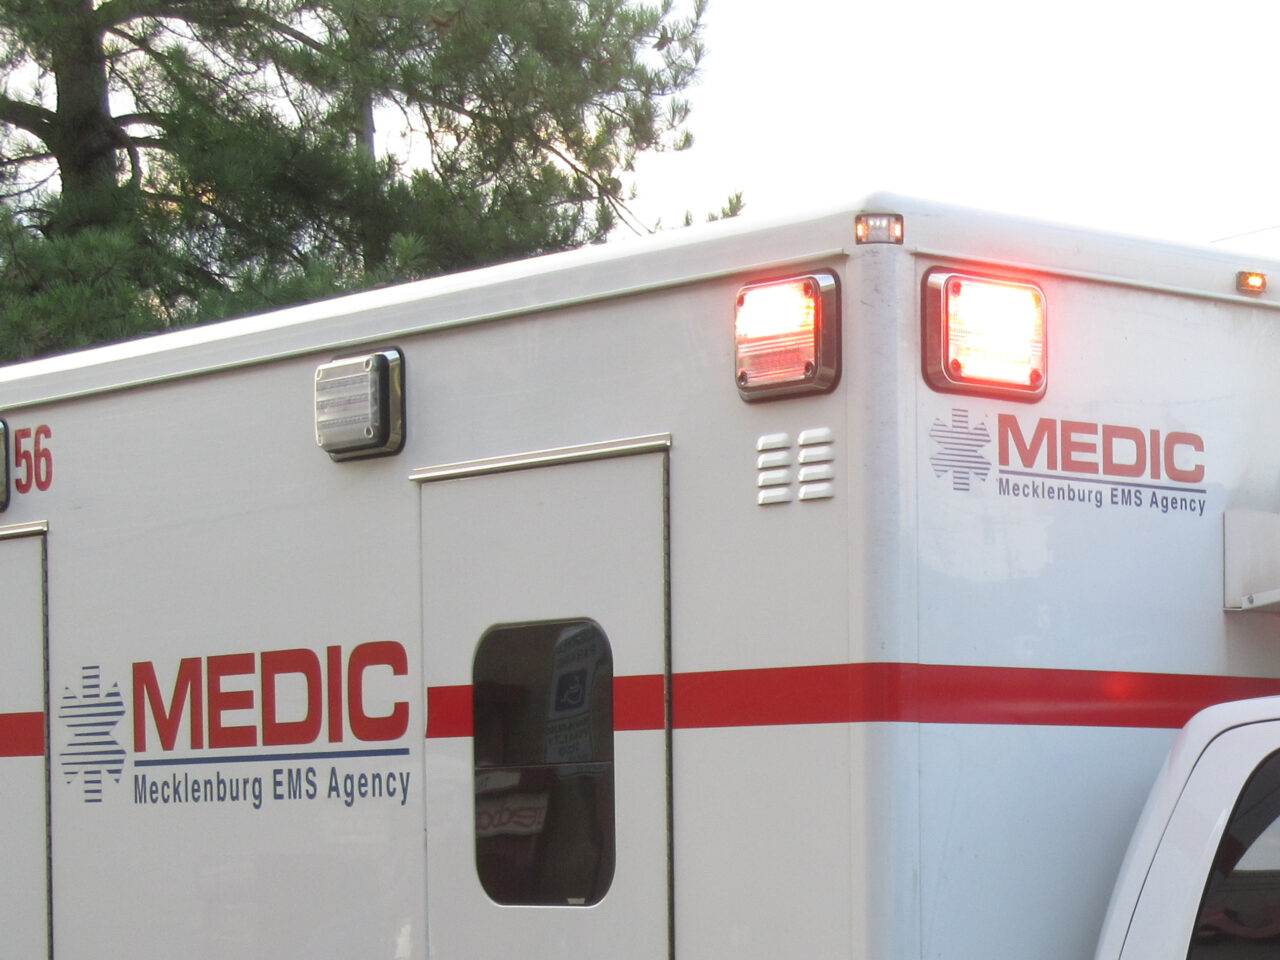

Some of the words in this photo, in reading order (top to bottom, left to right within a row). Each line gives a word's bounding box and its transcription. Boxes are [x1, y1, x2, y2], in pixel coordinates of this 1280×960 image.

[15, 425, 53, 494] 56
[997, 413, 1205, 483] MEDIC
[998, 477, 1103, 508] Mecklenburg
[1110, 487, 1143, 508] EMS
[1149, 491, 1207, 517] Agency
[133, 640, 410, 753] MEDIC
[134, 772, 264, 810] Mecklenburg
[272, 767, 317, 801] EMS
[327, 766, 410, 808] Agency
